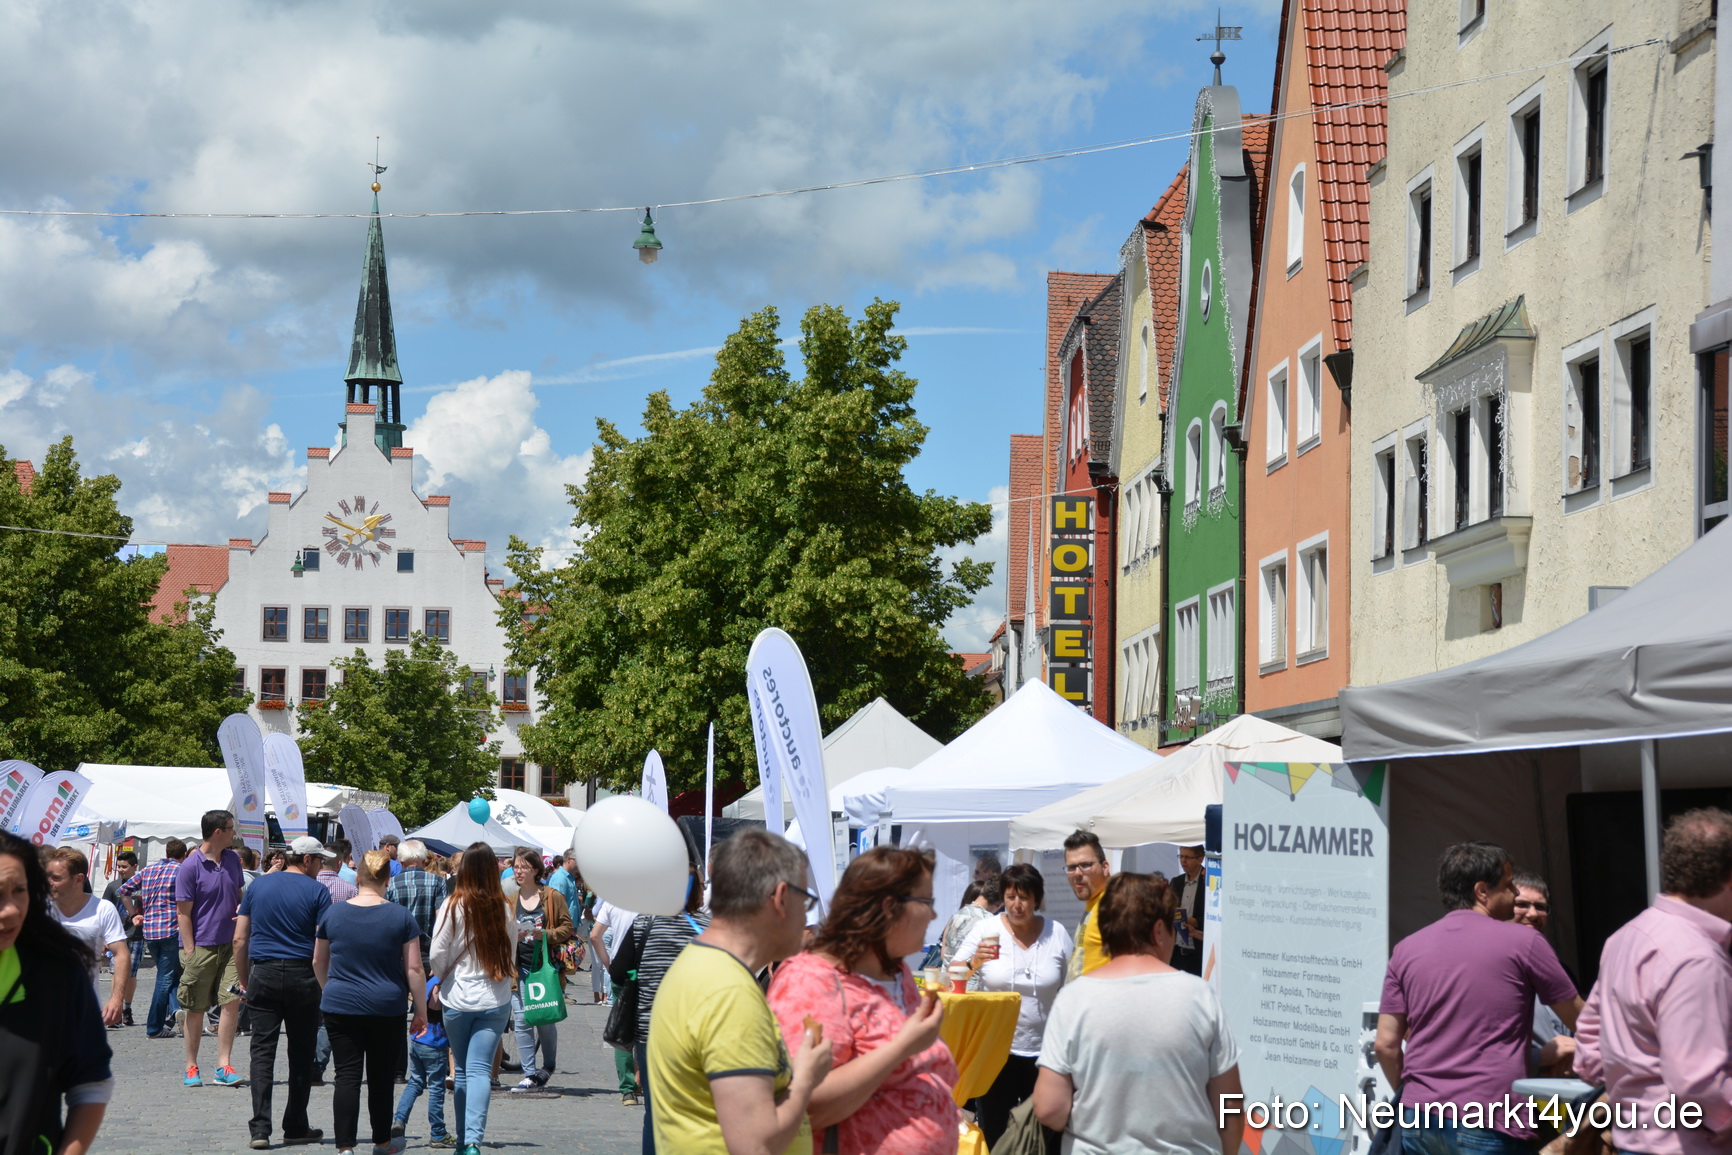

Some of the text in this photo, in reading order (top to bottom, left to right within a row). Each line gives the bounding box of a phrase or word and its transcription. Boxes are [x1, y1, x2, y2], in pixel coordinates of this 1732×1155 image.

[1053, 502, 1088, 700] HOTEL
[6, 780, 30, 818] BAUMARKT
[50, 823, 60, 837] DER
[57, 789, 80, 825] BAUMARKT
[1234, 823, 1375, 857] HOLZAMMER
[1235, 881, 1371, 901] Entwicklung Vorrichtungen Werkzeugbau
[1229, 895, 1255, 908] Montage
[1260, 898, 1297, 912] Verpackung
[1239, 911, 1284, 925] Prototypenbau
[1242, 948, 1363, 969] Holzammer Kunststofftechnik GmbH
[1262, 967, 1341, 984] Holzammer Formenbau
[528, 982, 546, 1000] D
[1262, 983, 1341, 1002] HKT Apolda, Thüringen
[1260, 1000, 1342, 1018] HKT Pohled, Tschechien
[1253, 1016, 1351, 1037] Holzammer Modellbau GmbH
[1249, 1034, 1262, 1043] eco
[1263, 1033, 1297, 1047] Kunststoff
[1299, 1038, 1320, 1050] GmbH
[1330, 1042, 1342, 1053] Co.
[1343, 1044, 1354, 1055] KG
[1264, 1051, 1338, 1070] Jean Holzammer GbR
